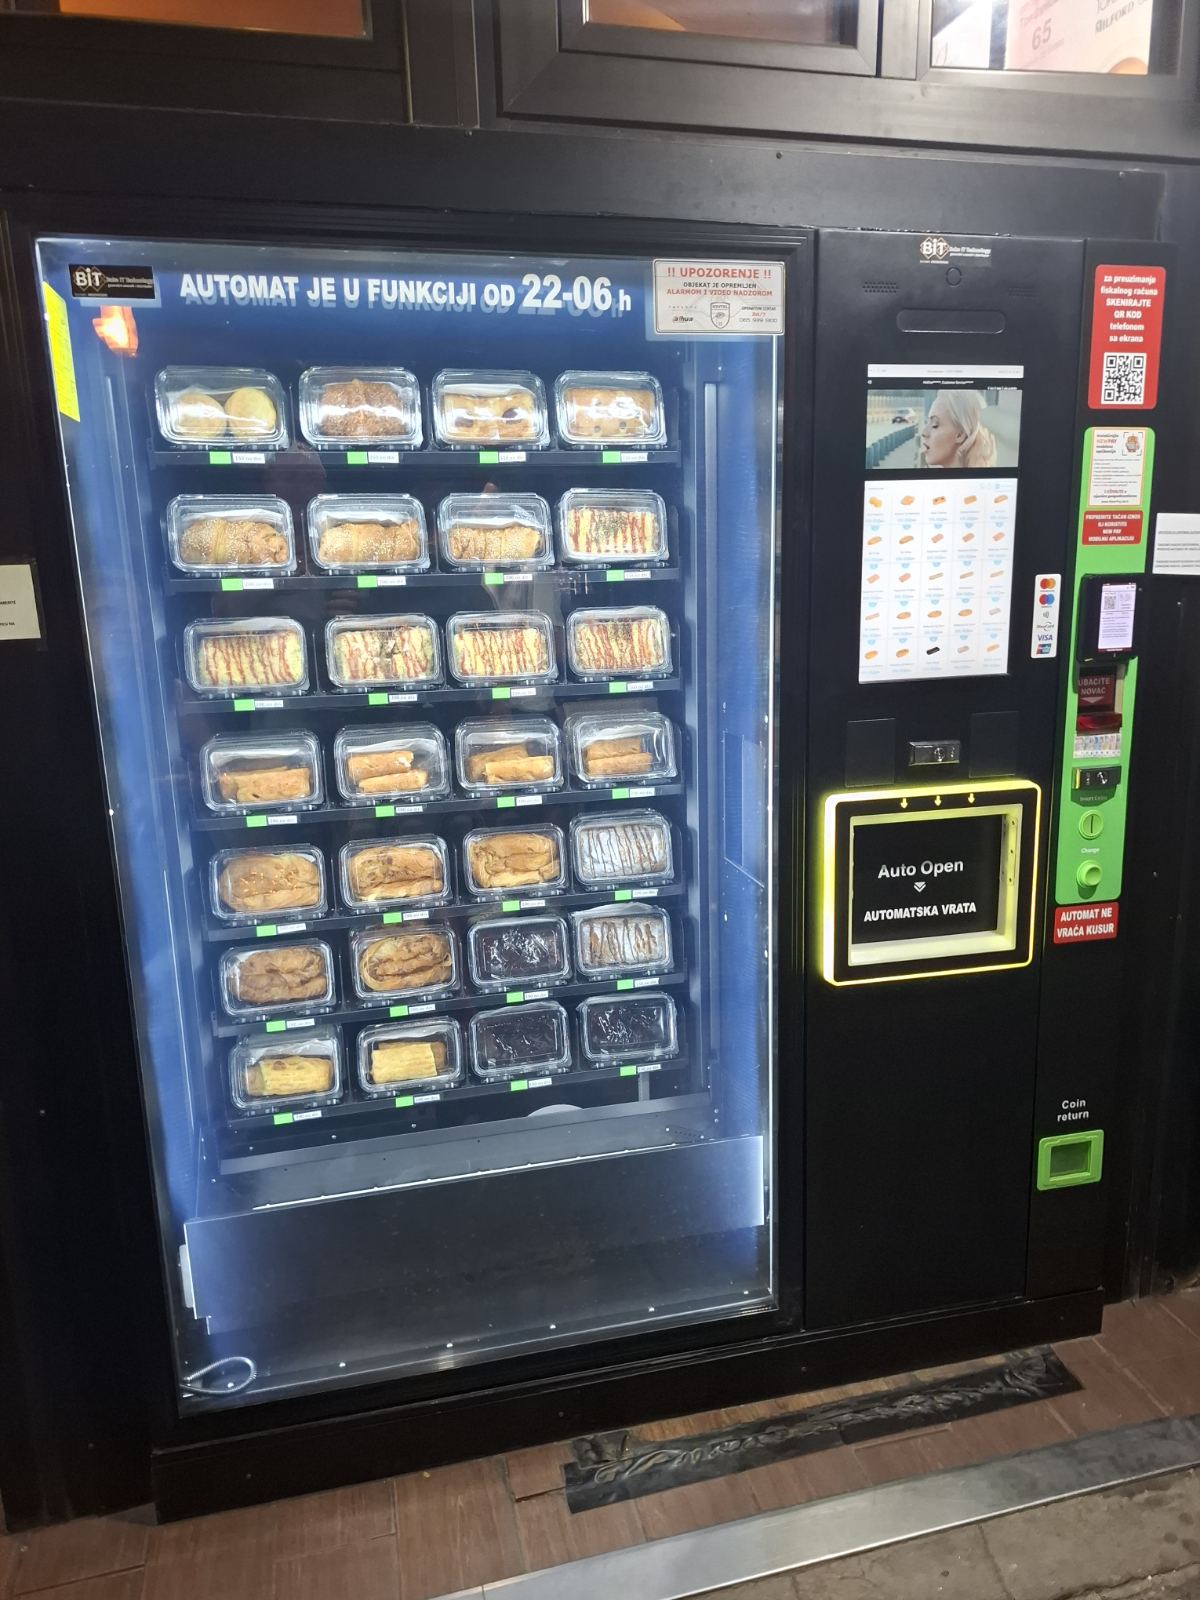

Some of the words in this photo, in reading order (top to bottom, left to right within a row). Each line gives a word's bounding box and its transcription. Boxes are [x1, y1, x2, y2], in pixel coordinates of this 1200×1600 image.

[1032, 18, 1052, 50] 65
[680, 267, 759, 279] UPOZORENJE
[1104, 275, 1113, 283] za
[1114, 274, 1156, 286] preuzimanje
[179, 273, 299, 300] AUTOMAT
[306, 277, 337, 300] JE
[343, 278, 360, 301] U
[367, 278, 476, 305] FUNKCIJI
[483, 283, 516, 306] OD
[521, 273, 612, 311] 22-06
[619, 289, 632, 312] h
[1101, 286, 1132, 296] fiskalnog
[1134, 286, 1158, 296] računa
[1106, 298, 1152, 307] SKENIRAJTE
[1114, 310, 1125, 319] QR
[1126, 310, 1142, 319] KOD
[1110, 322, 1144, 331] telefonom
[1119, 335, 1143, 343] ekrana
[1078, 677, 1110, 687] UBACITE
[1081, 686, 1106, 695] NOVAC
[877, 864, 917, 879] Auto
[920, 860, 964, 877] Open
[863, 905, 939, 922] AUTOMATSKA
[941, 902, 977, 915] VRATA
[1060, 908, 1099, 922] AUTOMAT
[1101, 907, 1113, 918] NE
[1056, 925, 1084, 938] VRAĆA
[1086, 923, 1114, 935] KUSUR
[1061, 1098, 1086, 1110] Coin
[1057, 1110, 1090, 1122] return
